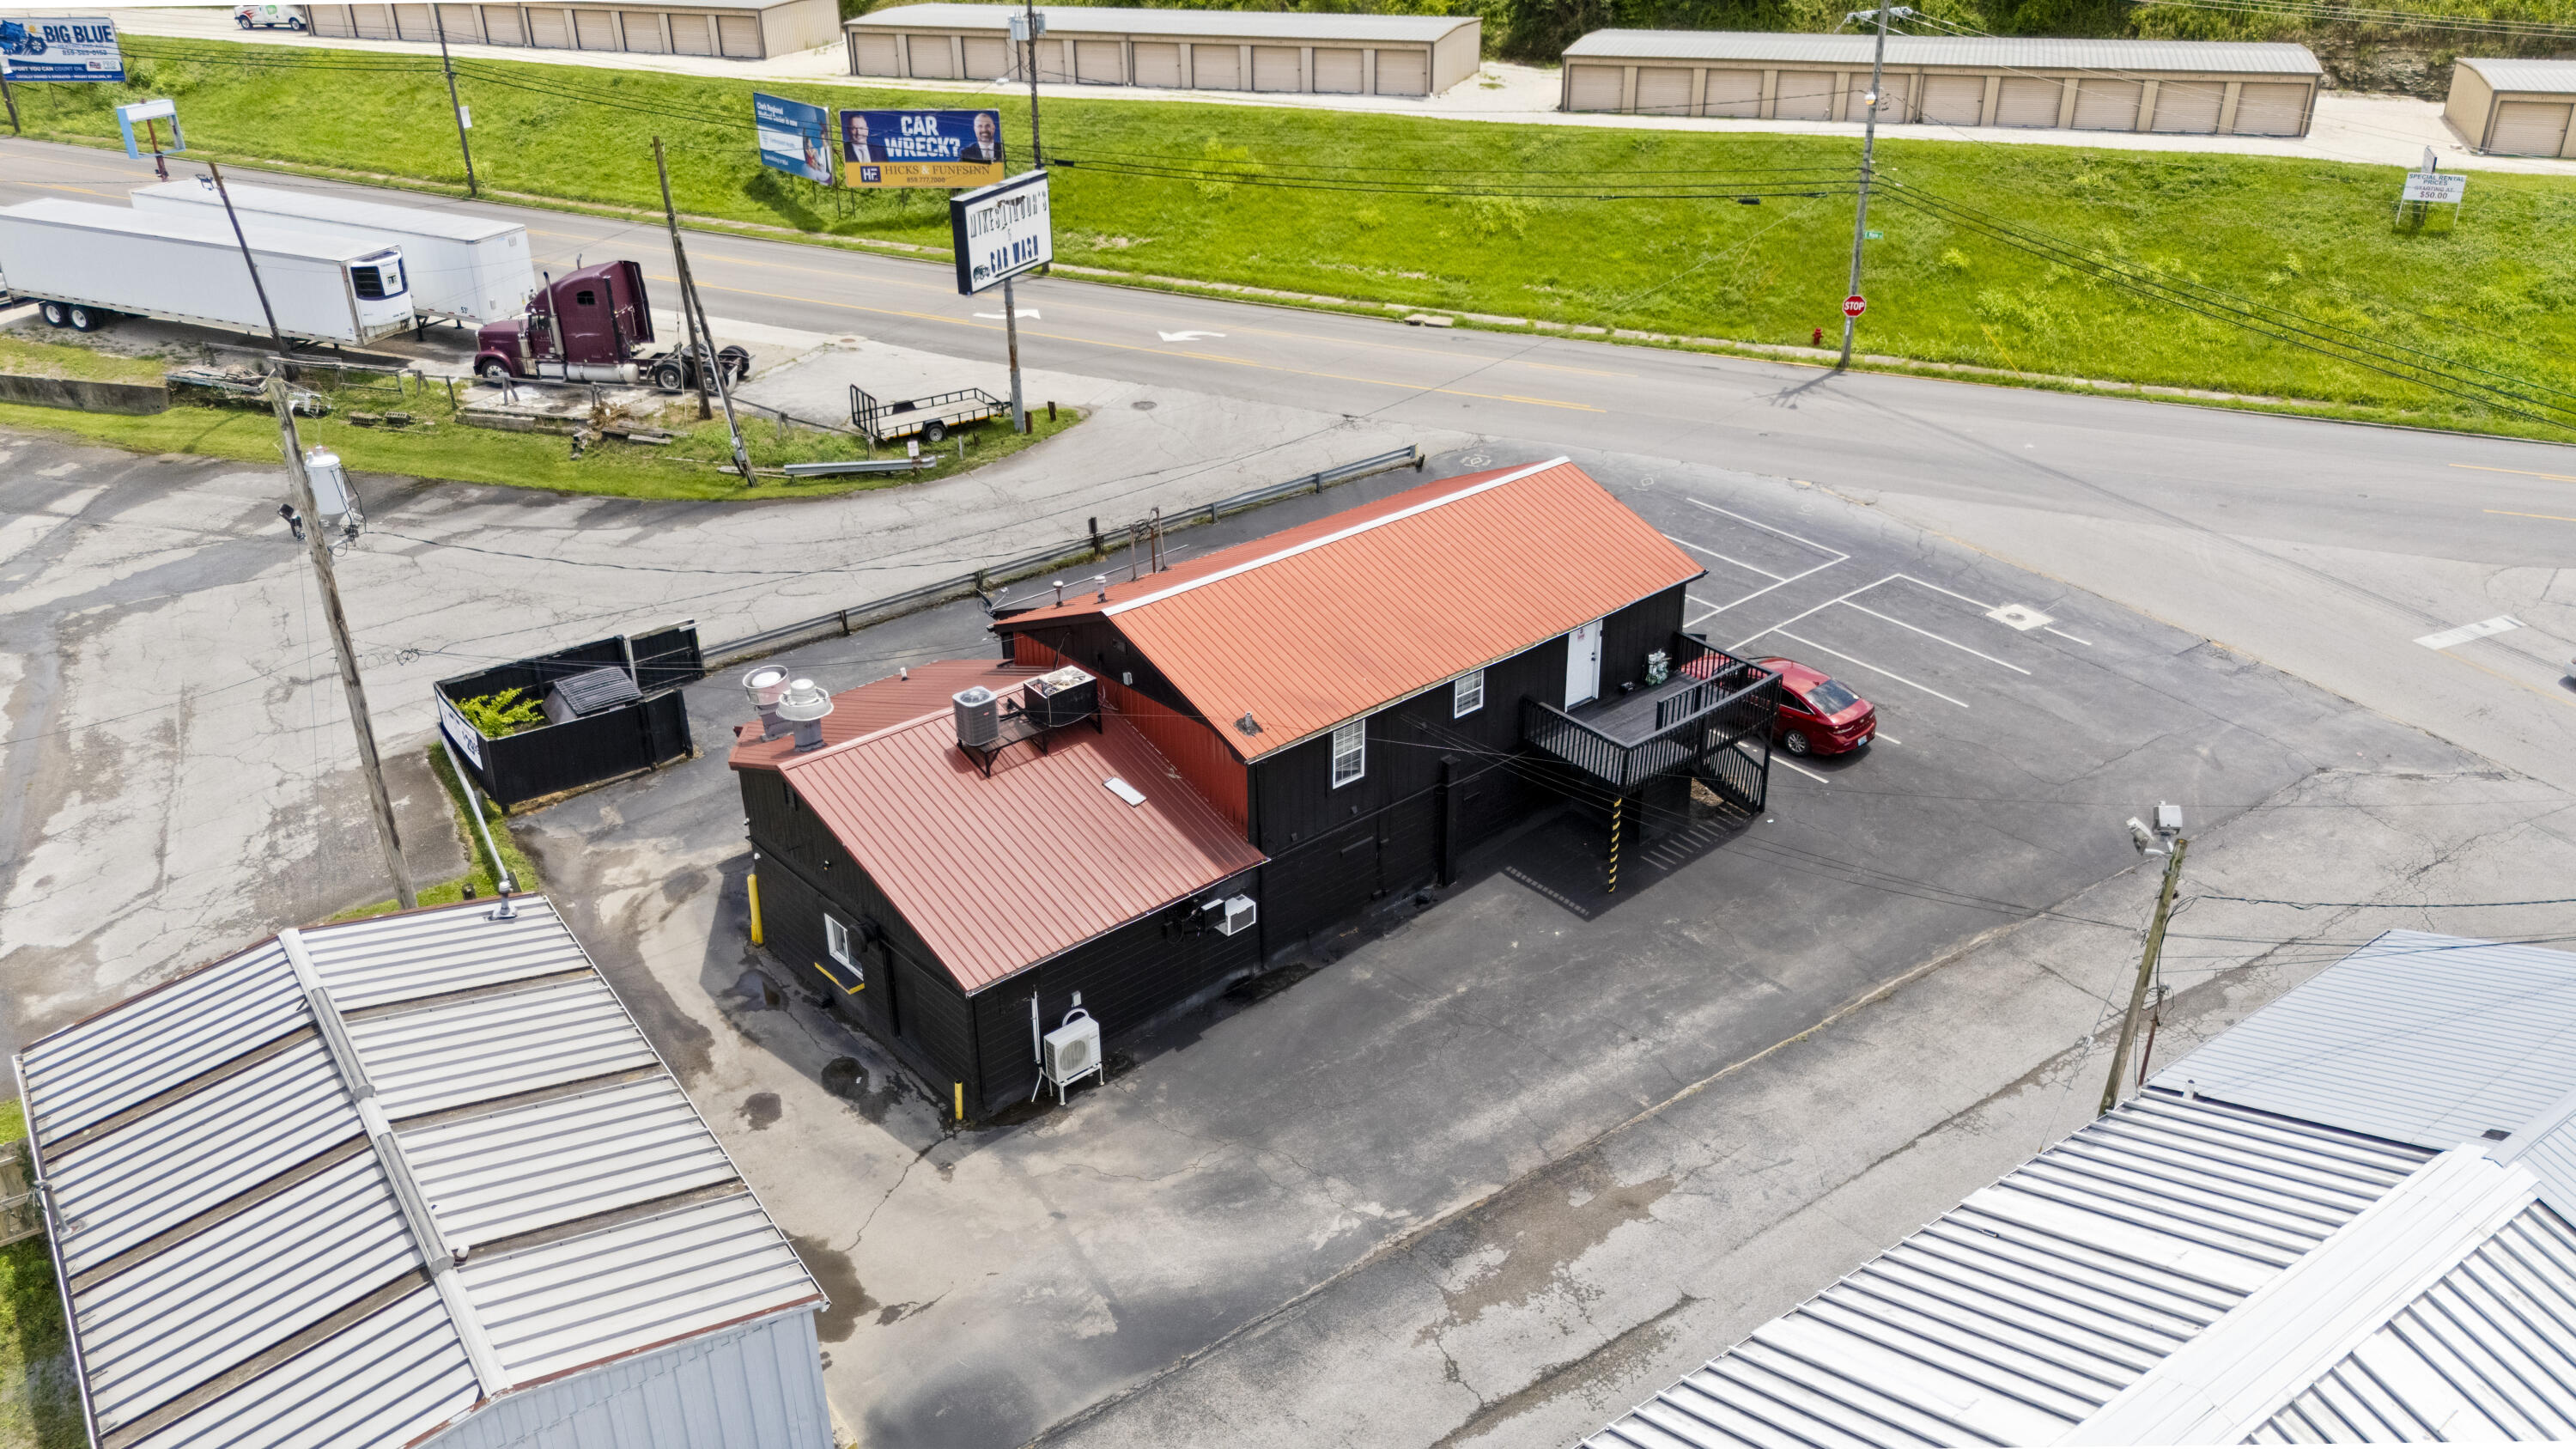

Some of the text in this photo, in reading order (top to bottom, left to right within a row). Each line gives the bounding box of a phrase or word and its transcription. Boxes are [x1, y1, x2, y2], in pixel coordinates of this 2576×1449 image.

[43, 25, 114, 43] BIG BLUE
[900, 115, 939, 137] CAR
[884, 137, 961, 157] WRECK?
[884, 165, 990, 175] HICKS & FUNFSINN
[2420, 191, 2448, 199] $50.00
[969, 205, 1000, 239] MIKES
[990, 234, 1039, 273] CAR WASH
[1844, 301, 1865, 311] STOP
